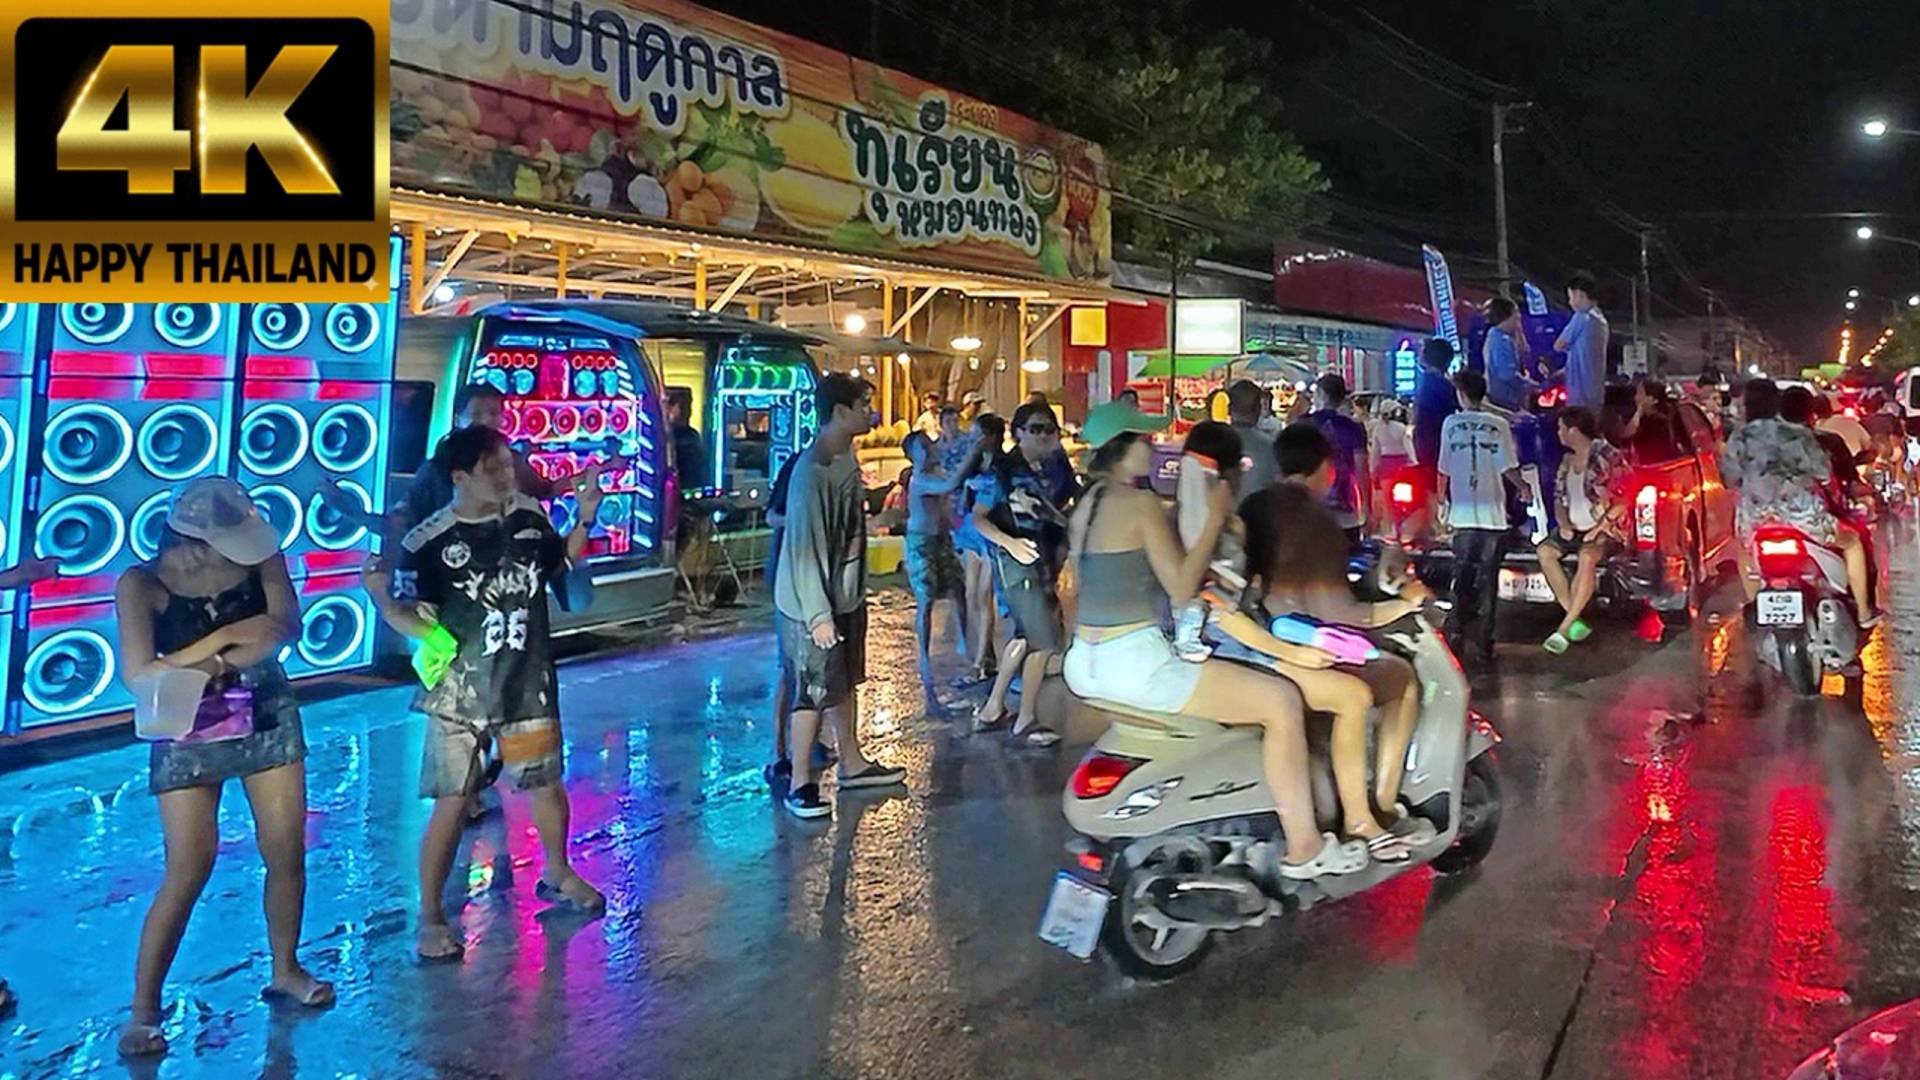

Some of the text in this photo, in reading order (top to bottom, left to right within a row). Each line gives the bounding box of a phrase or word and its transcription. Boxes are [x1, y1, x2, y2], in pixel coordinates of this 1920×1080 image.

[846, 99, 1020, 223] ทุเรียน
[897, 198, 1038, 247] หมอนทอง
